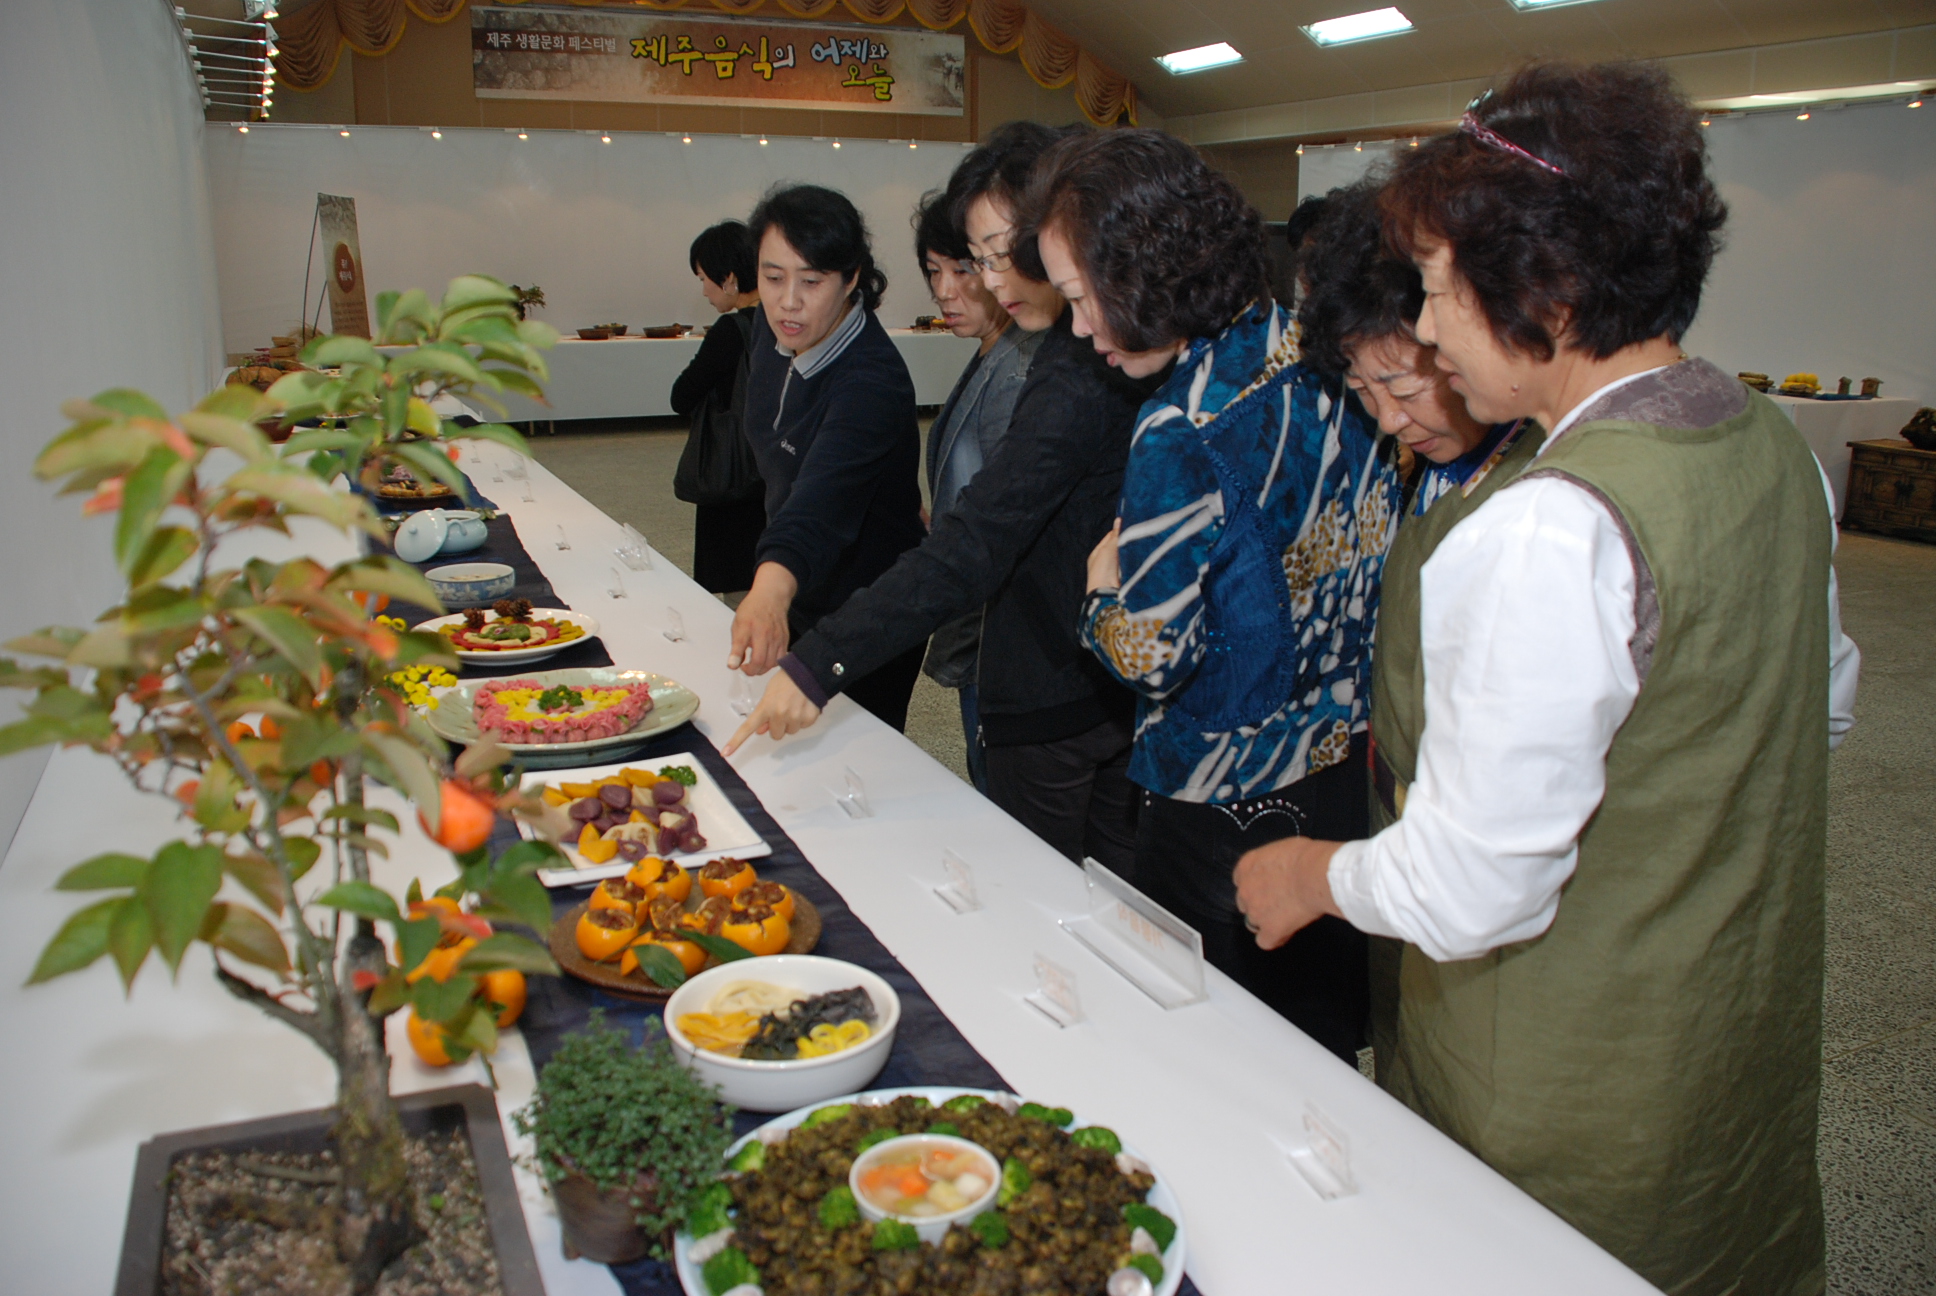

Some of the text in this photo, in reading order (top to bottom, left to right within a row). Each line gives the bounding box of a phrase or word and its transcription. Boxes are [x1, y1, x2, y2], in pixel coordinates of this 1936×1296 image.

[486, 31, 617, 53] 제주 생활문화 페스티벌
[630, 35, 888, 80] 제주음식의 어제와
[842, 64, 894, 101] 오늘
